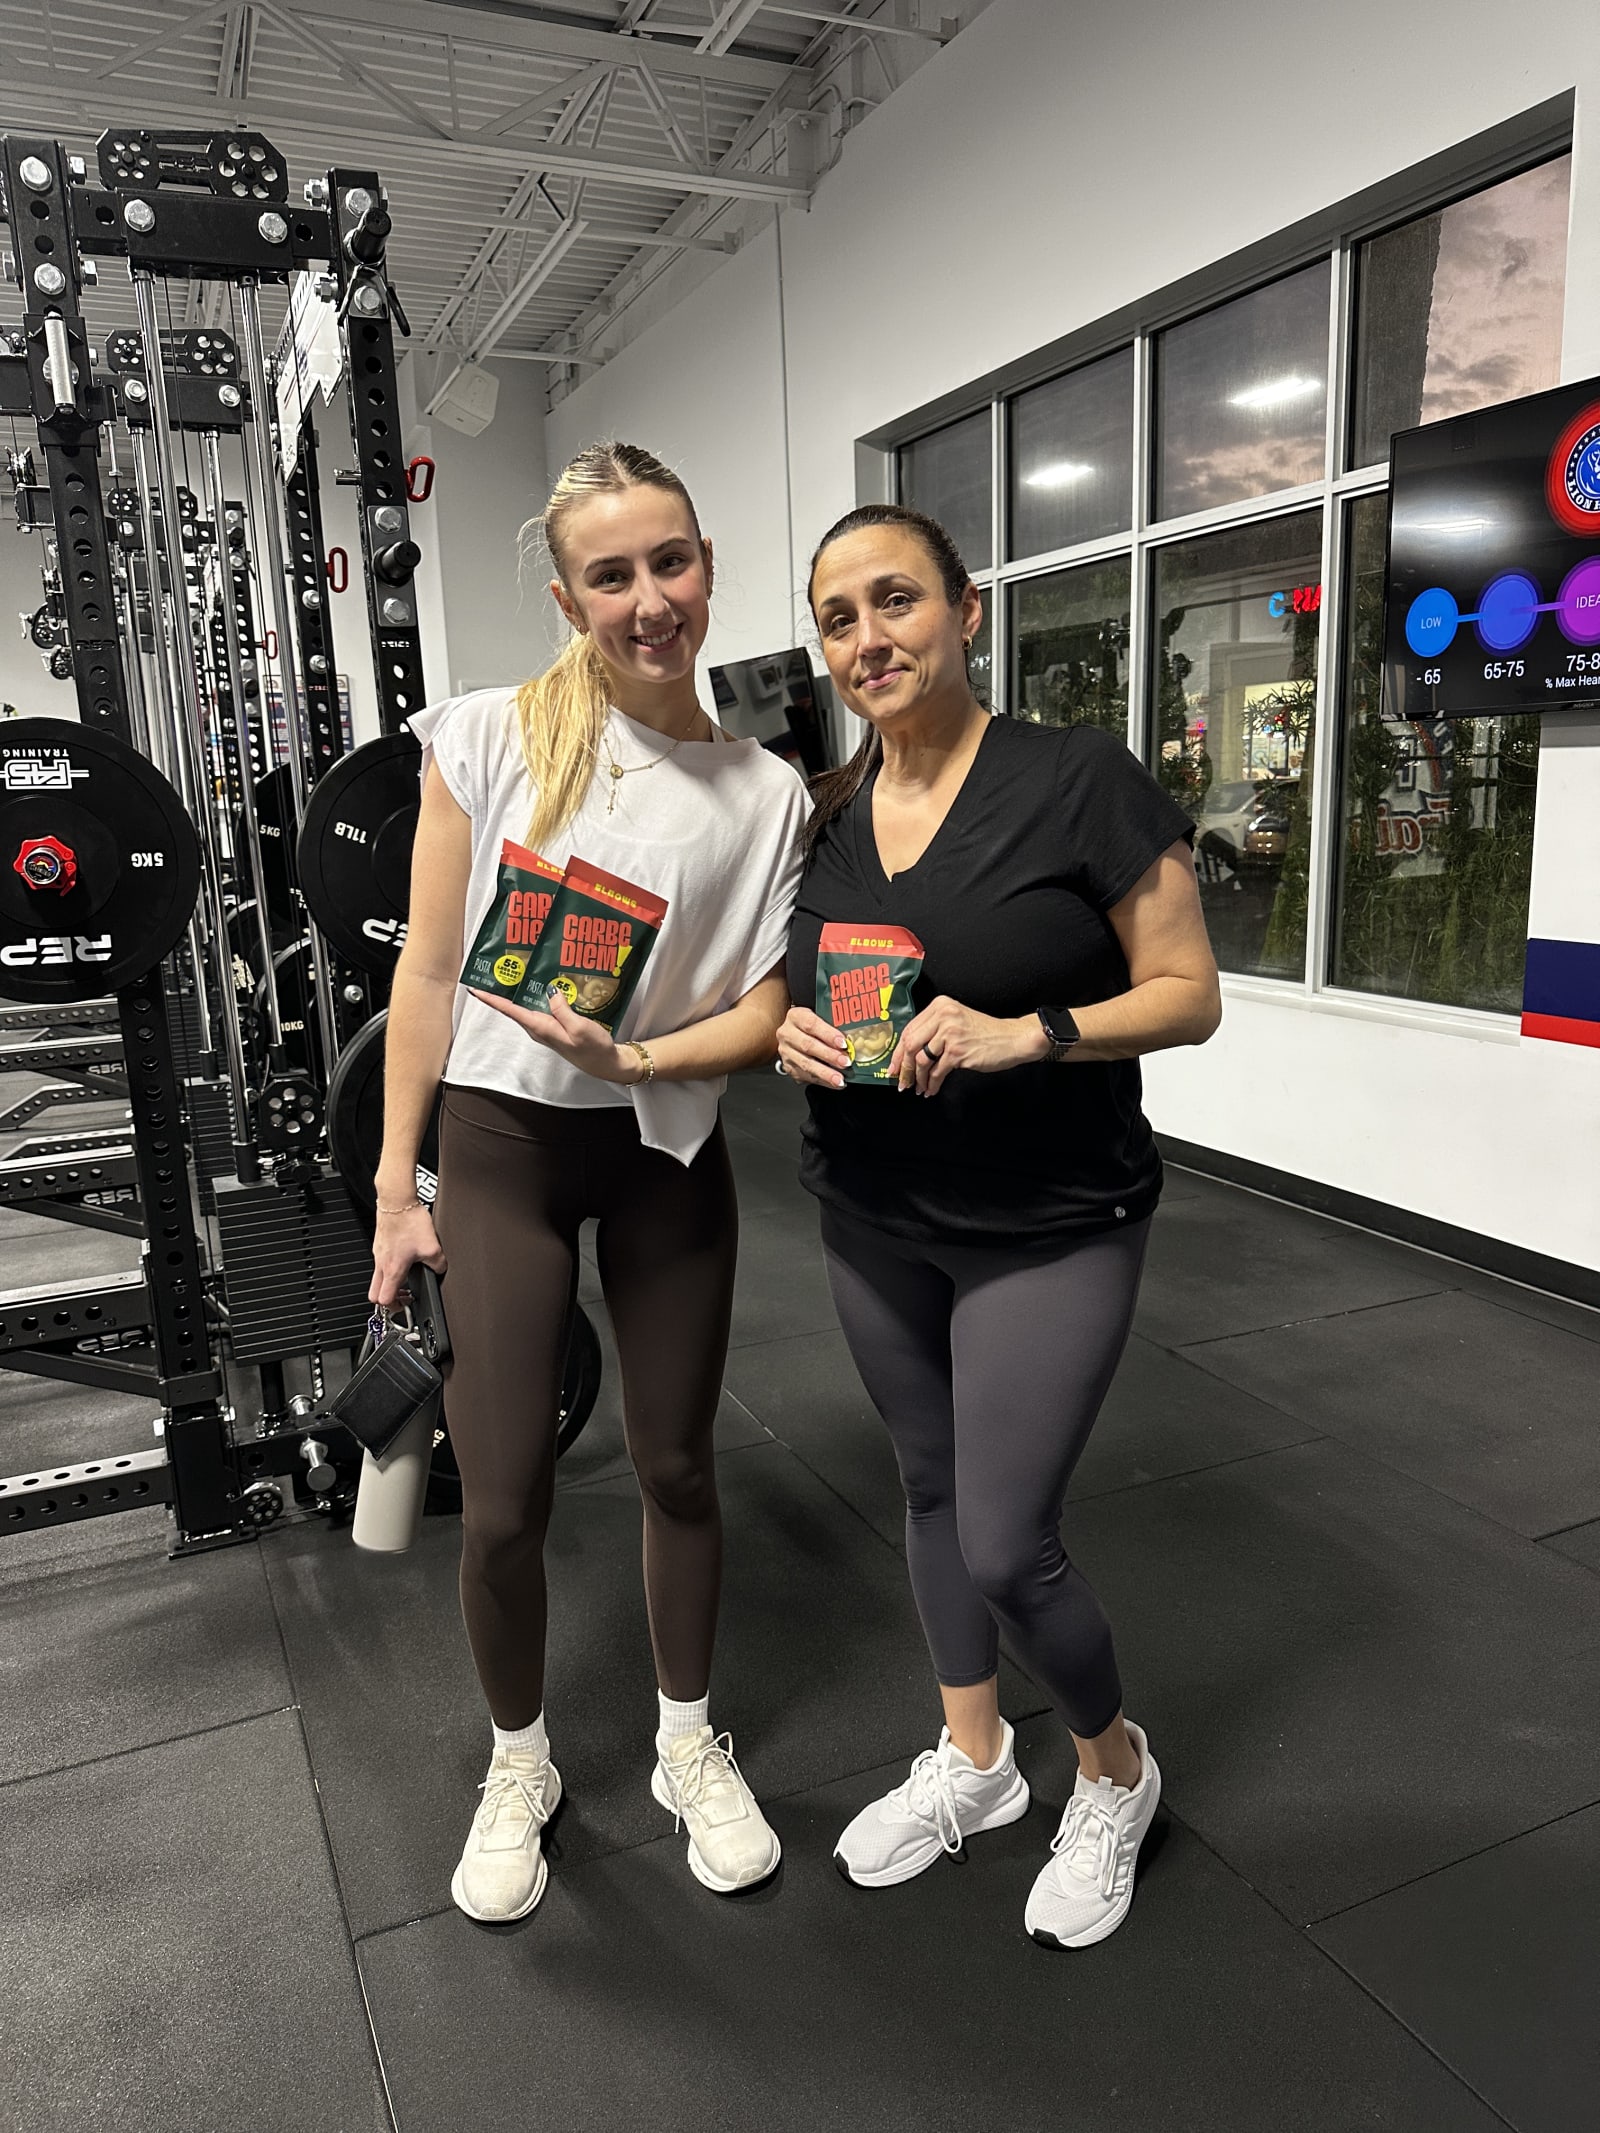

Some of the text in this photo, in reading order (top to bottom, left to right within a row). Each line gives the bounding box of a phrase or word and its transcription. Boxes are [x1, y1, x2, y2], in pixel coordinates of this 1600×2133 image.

[1568, 479, 1593, 509] LION
[1576, 594, 1600, 609] IDEA
[1421, 616, 1442, 630] LOW
[1484, 660, 1525, 680] 65-75
[1566, 652, 1600, 672] 75-8
[1555, 676, 1576, 688] Max
[1578, 674, 1600, 686] Hear
[2, 748, 69, 758] TRAINING
[6, 760, 70, 788] F45
[259, 824, 281, 838] 5KG
[334, 821, 367, 844] 11LB
[131, 852, 164, 868] 5KG
[508, 890, 556, 919] CAR
[594, 883, 638, 908] ELBOWS
[506, 916, 544, 945] DIE
[563, 913, 632, 947] CARBE
[0, 934, 112, 966] REP
[850, 937, 894, 948] ELBOWS
[473, 957, 492, 975] PASTA
[526, 979, 544, 996] PASTA
[829, 962, 890, 1001] CARBE
[416, 1169, 438, 1200] 45
